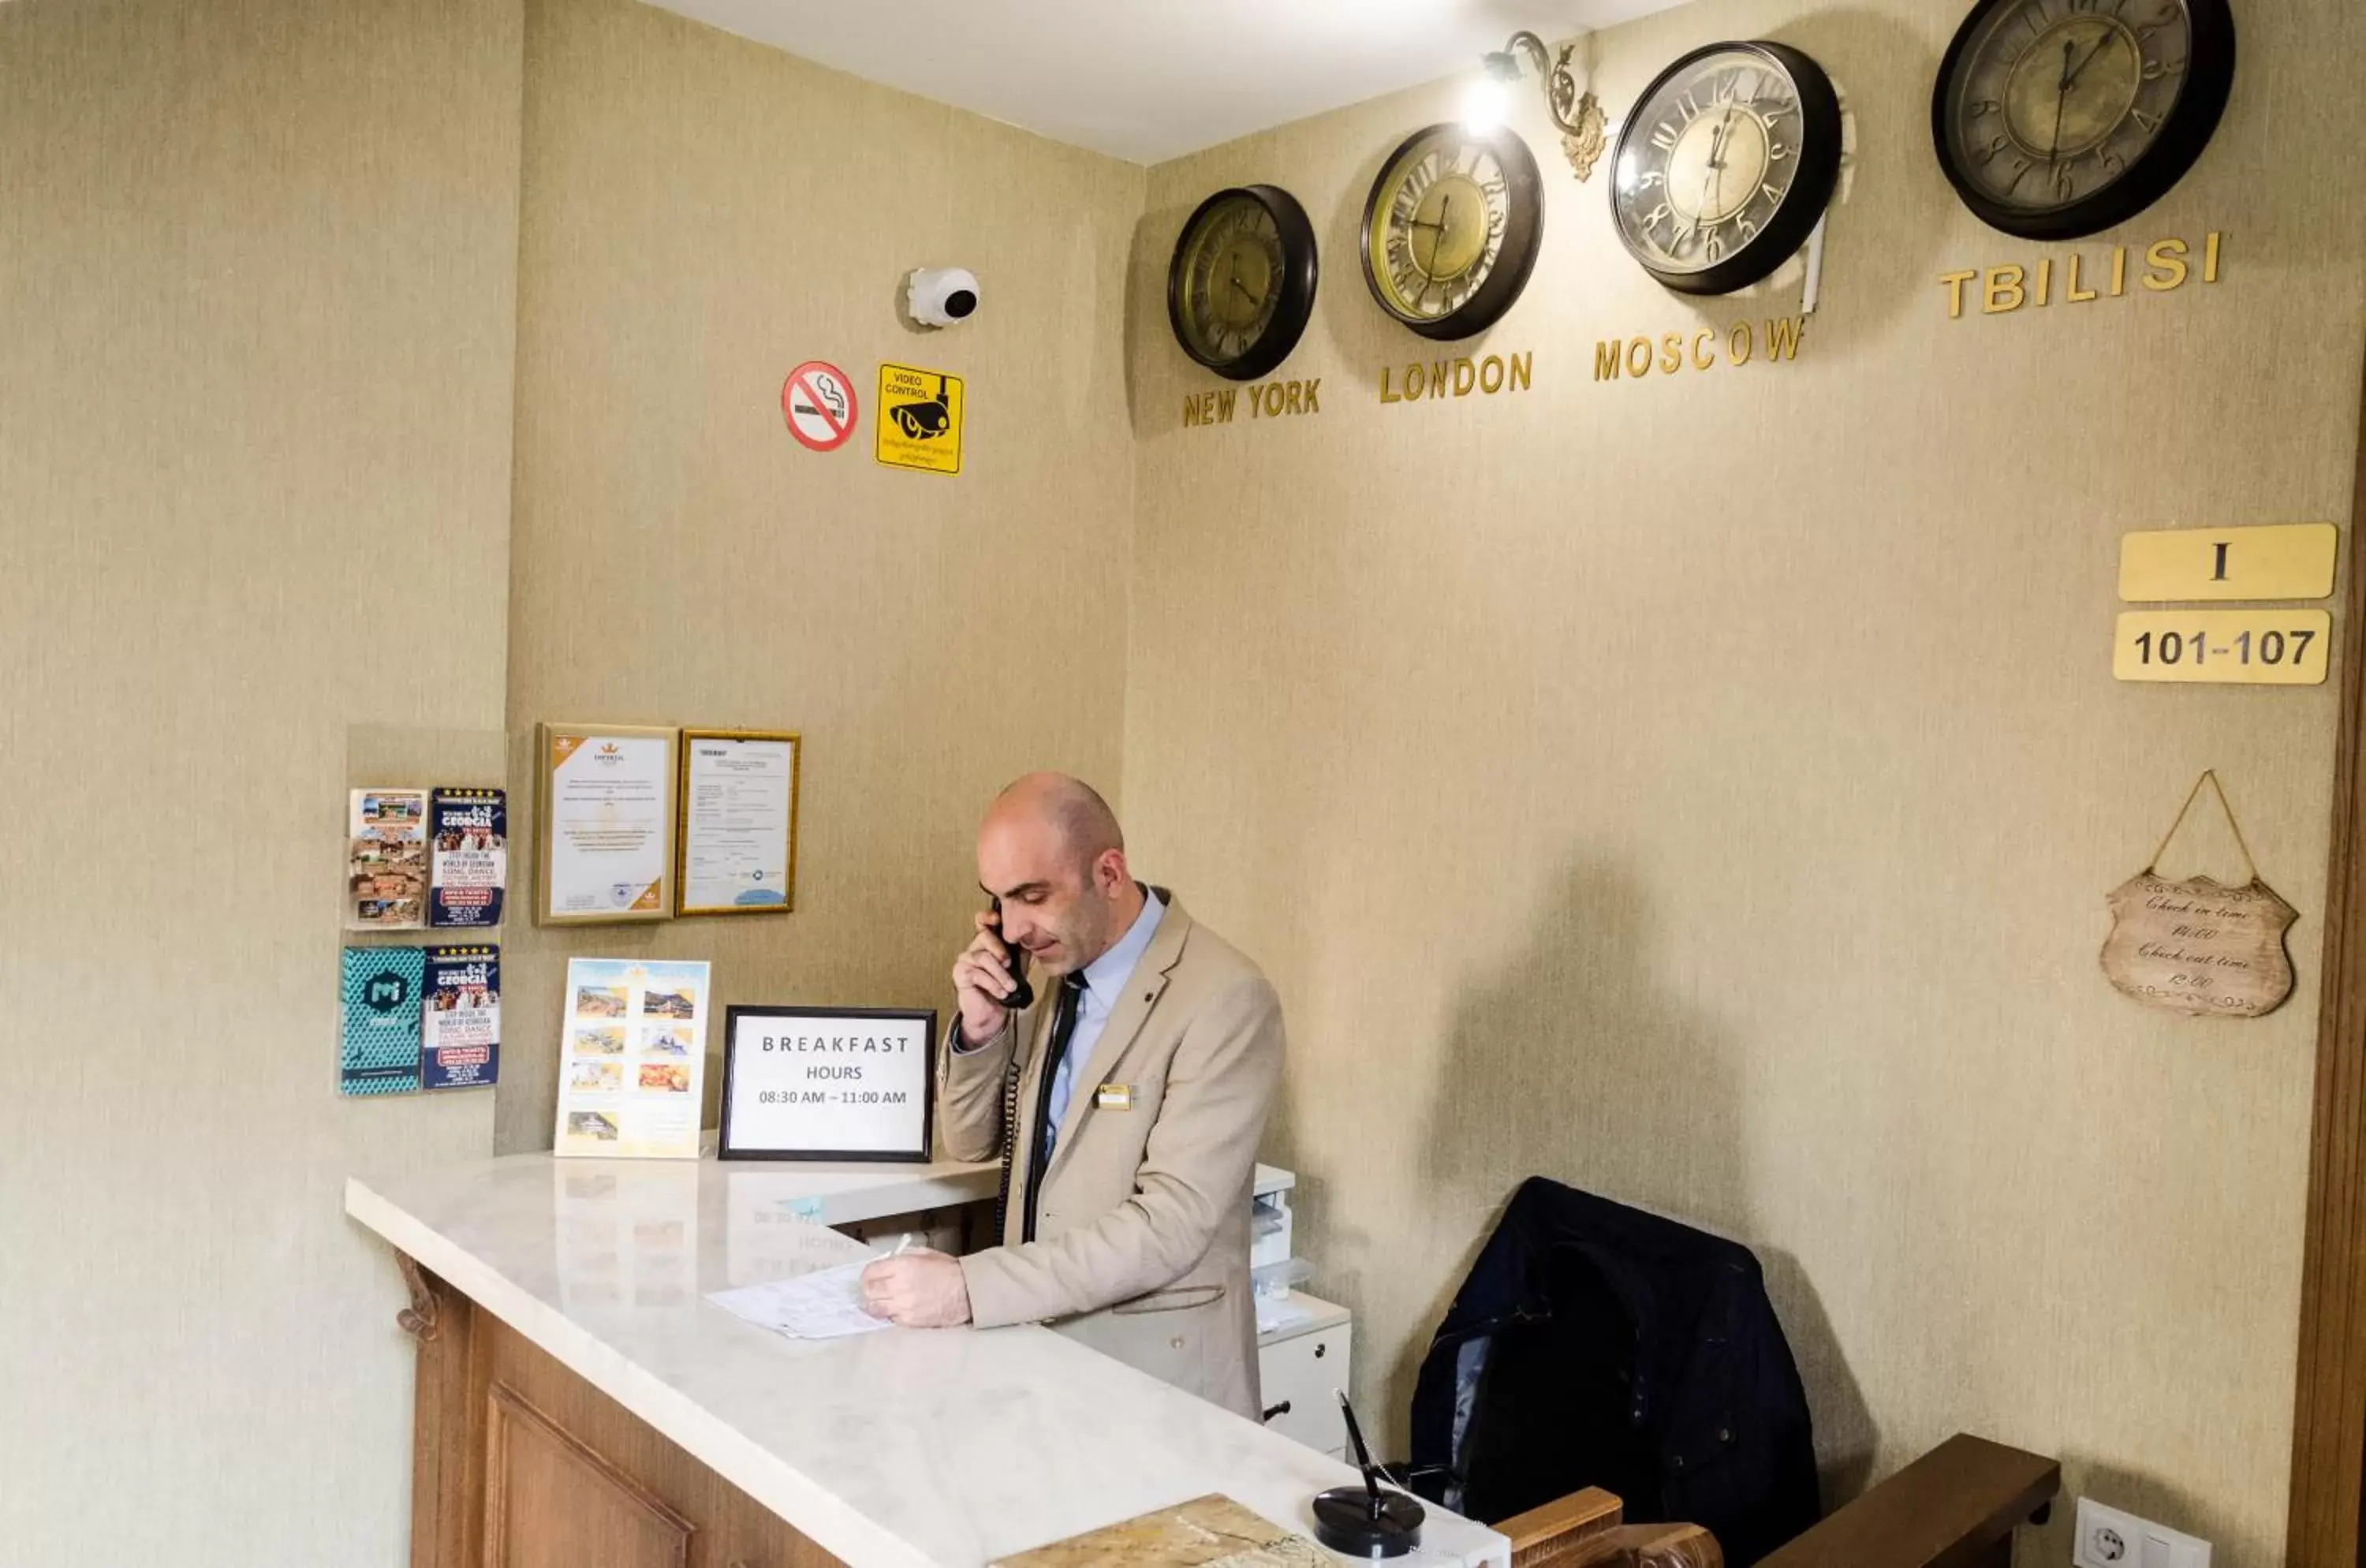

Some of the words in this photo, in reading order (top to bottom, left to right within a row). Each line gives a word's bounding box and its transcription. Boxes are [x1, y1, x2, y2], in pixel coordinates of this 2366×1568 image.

[1674, 88, 1700, 122] 11
[2131, 107, 2164, 134] 4
[1650, 121, 1680, 151] 10
[1640, 170, 1663, 190] 9
[1761, 181, 1787, 204] 4
[2008, 159, 2034, 196] 7
[2052, 159, 2074, 202] 6
[1643, 202, 1674, 232] 8
[1736, 210, 1757, 241] 5
[1669, 225, 1692, 258] 7
[1939, 232, 2219, 319] TBILISI
[1594, 316, 1804, 382] MOSCOW
[885, 384, 928, 399] CONTROL
[893, 372, 922, 386] VIDEO
[1379, 351, 1532, 404] LONDON
[1183, 390, 1237, 427] NEW
[1246, 378, 1321, 419] YORK
[2208, 542, 2233, 581] I
[2134, 630, 2316, 665] 101-107
[442, 816, 493, 827] GEORGIA
[2146, 896, 2193, 913] Check
[2216, 908, 2247, 919] time
[2138, 943, 2185, 960] Check
[438, 975, 487, 986] GEORGIA
[763, 1036, 909, 1052] BREAKFAST
[807, 1066, 862, 1080] HOURS
[759, 1091, 797, 1103] 08:30
[801, 1091, 825, 1103] AM
[842, 1092, 879, 1103] 11:00
[883, 1092, 906, 1103] AM
